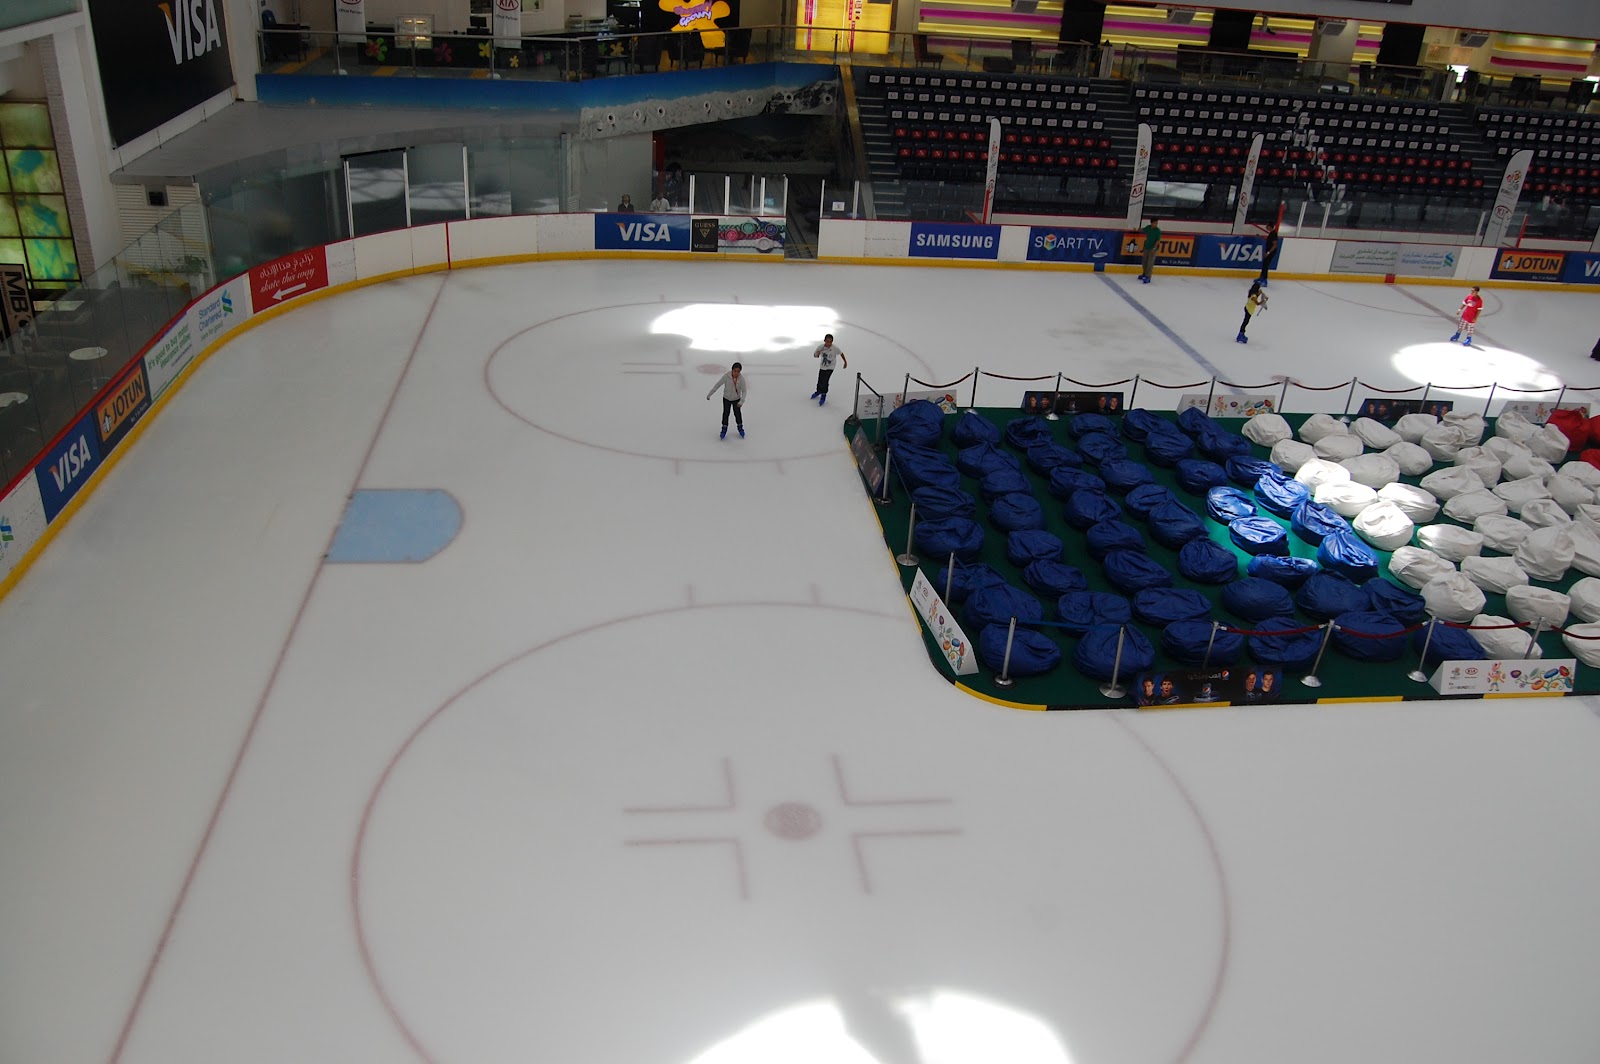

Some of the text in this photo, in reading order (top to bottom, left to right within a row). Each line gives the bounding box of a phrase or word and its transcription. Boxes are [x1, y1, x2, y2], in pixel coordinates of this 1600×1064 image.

[158, 0, 222, 65] VISA
[615, 222, 671, 242] VISA
[916, 233, 994, 249] SAMSUNG
[1087, 238, 1104, 250] TV
[1140, 240, 1191, 255] JTUN
[1218, 242, 1264, 262] VISA
[1514, 257, 1560, 271] JOTUN
[198, 297, 221, 319] Standard
[198, 310, 223, 332] Chartered
[112, 373, 145, 424] JOTUN
[49, 434, 91, 492] VISA
